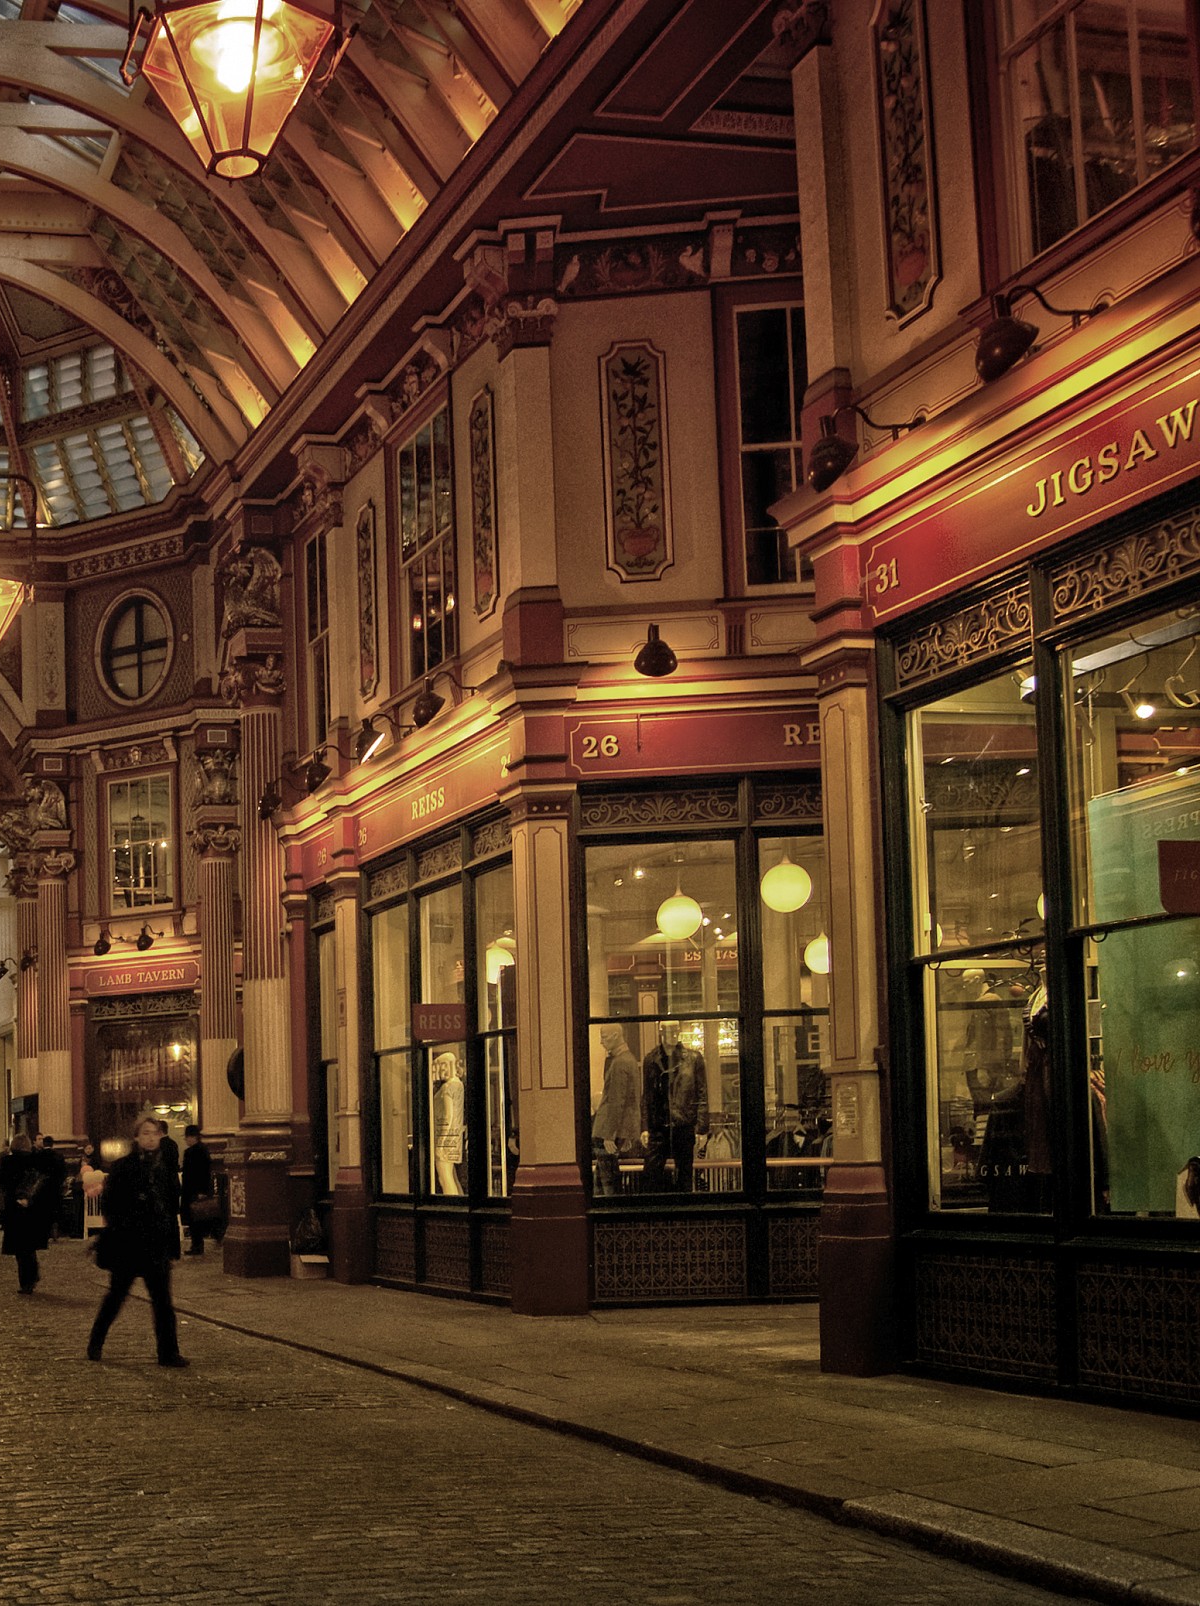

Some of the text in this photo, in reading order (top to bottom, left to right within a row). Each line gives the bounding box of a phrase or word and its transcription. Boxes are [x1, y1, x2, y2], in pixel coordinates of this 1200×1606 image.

[1026, 399, 1200, 517] JIGSAW
[875, 557, 899, 593] 31
[582, 723, 821, 758] 26 RE
[411, 786, 445, 821] REISS
[358, 827, 367, 847] 26
[317, 847, 327, 867] 26
[99, 968, 185, 987] LAMB TAVERN
[419, 1014, 462, 1030] REISS
